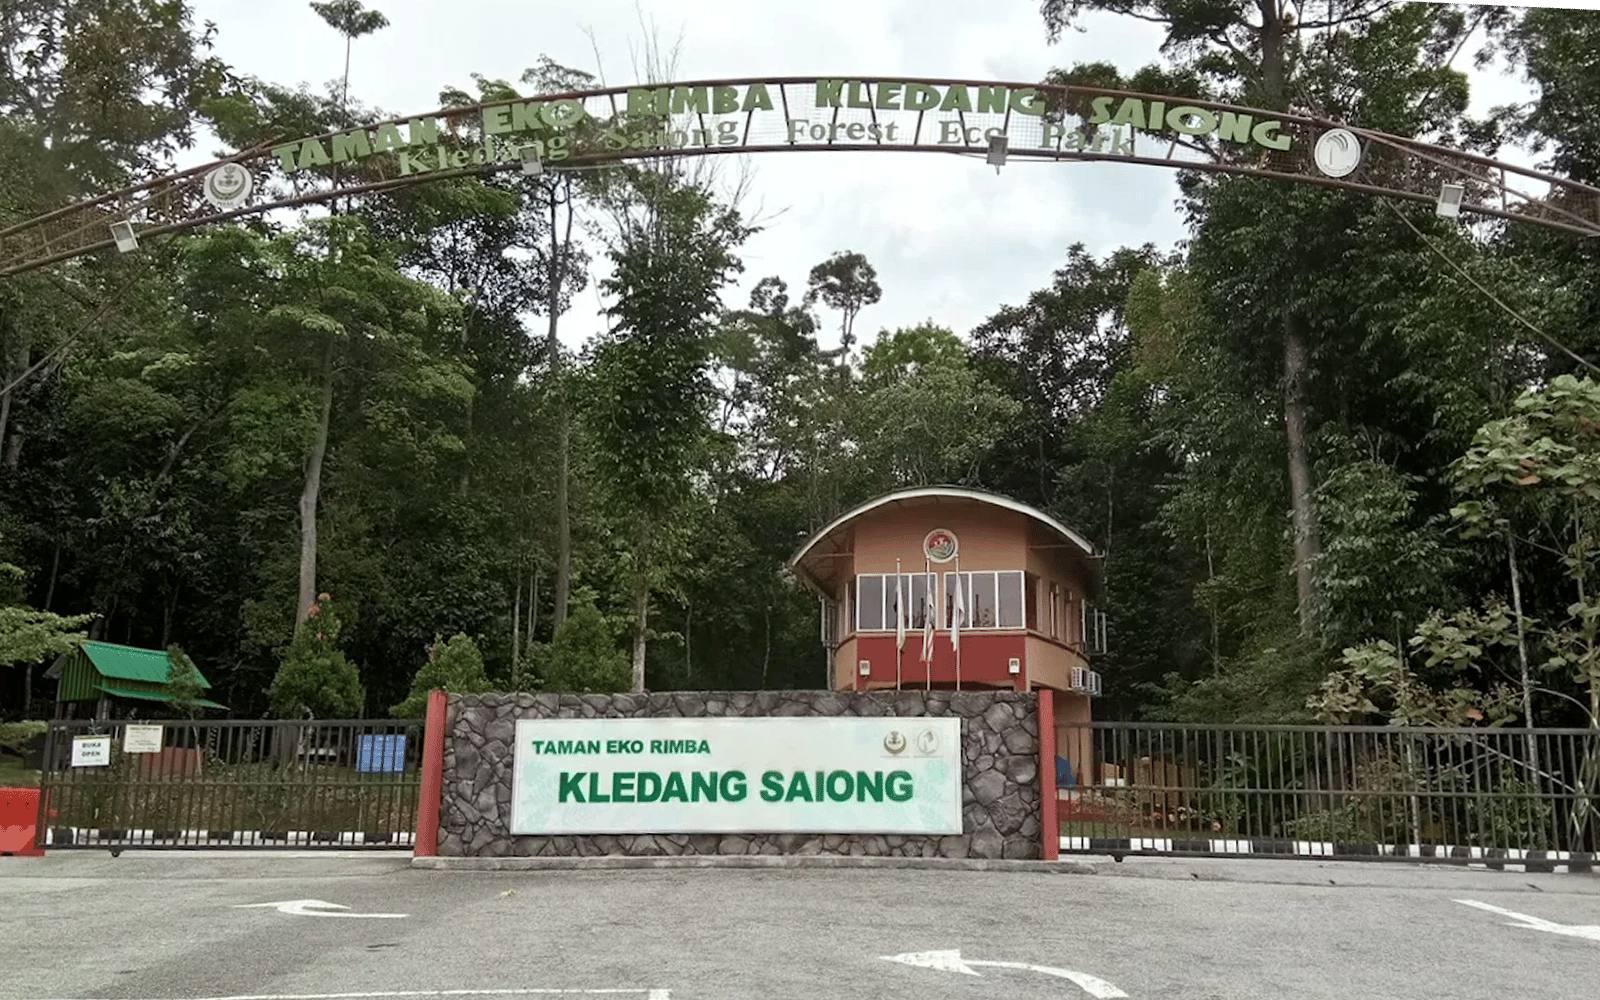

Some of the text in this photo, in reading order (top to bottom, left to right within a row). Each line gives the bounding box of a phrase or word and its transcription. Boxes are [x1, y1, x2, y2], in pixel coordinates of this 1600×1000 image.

[272, 79, 1291, 173] TAMAN EKO RIMBA KLEDANG SAIONG
[604, 120, 739, 150] Saiong
[784, 118, 899, 143] Forest
[937, 120, 1005, 145] Eco
[1038, 121, 1136, 157] Park
[532, 739, 711, 755] TAMAN EKO RIMBA
[558, 769, 914, 803] KLEDANG SAIONG
